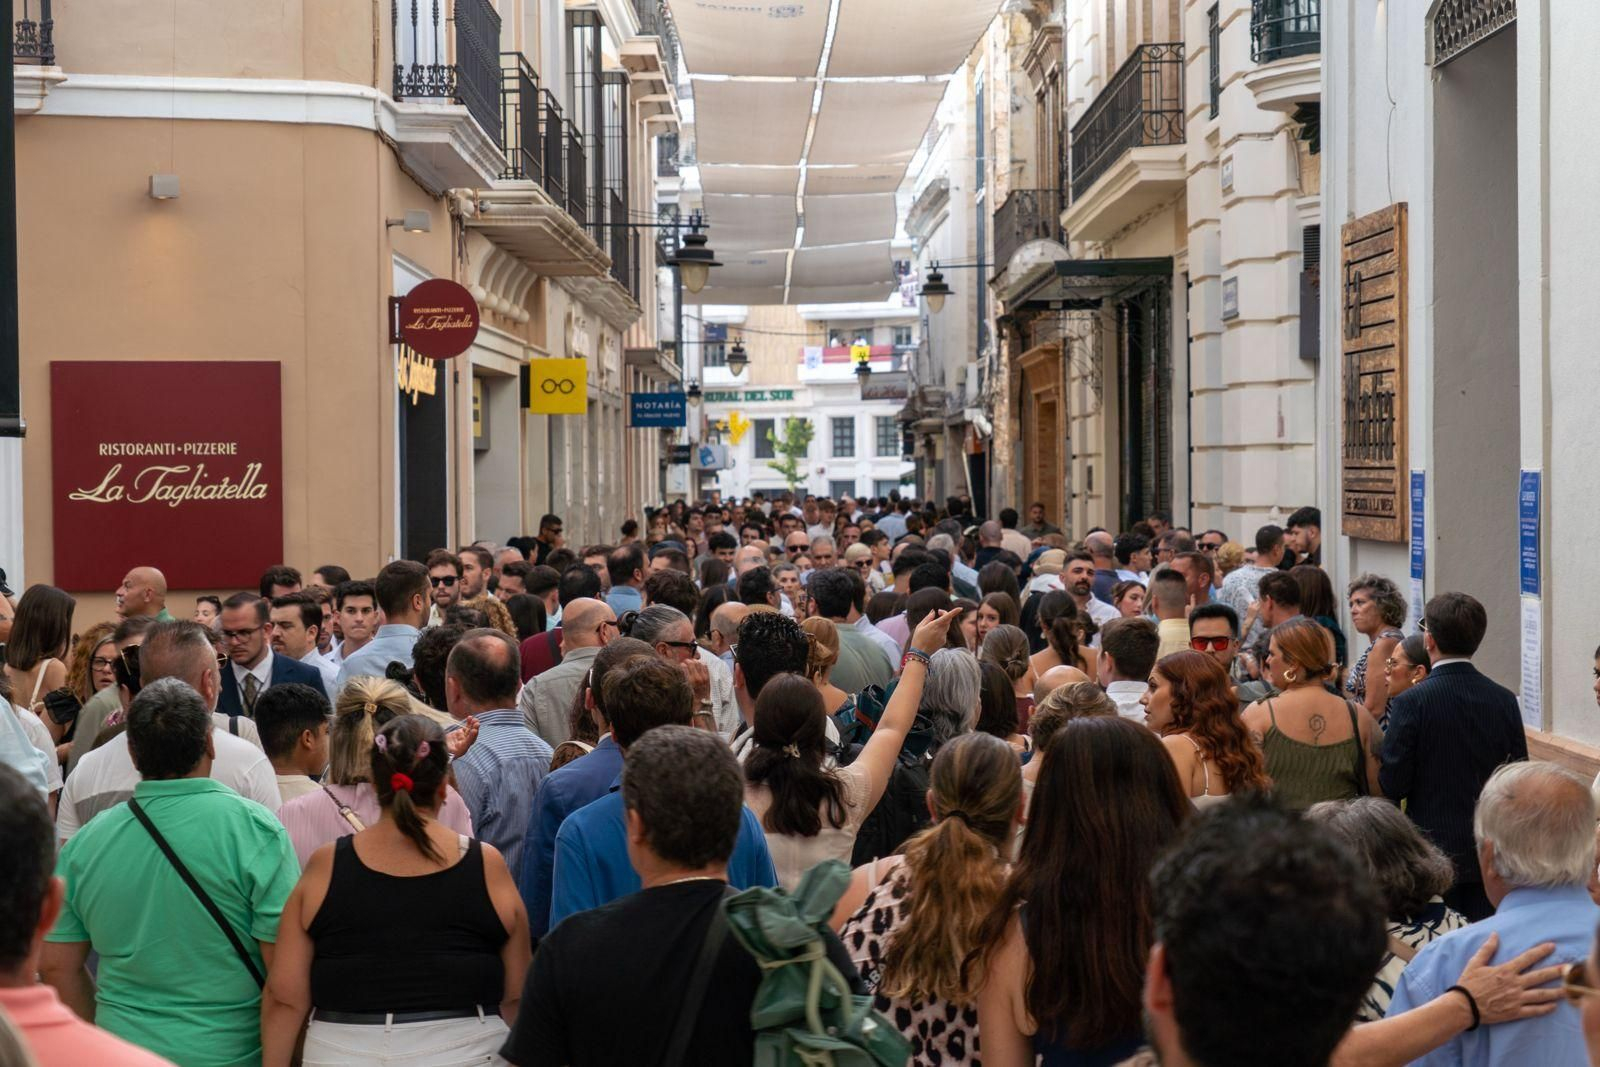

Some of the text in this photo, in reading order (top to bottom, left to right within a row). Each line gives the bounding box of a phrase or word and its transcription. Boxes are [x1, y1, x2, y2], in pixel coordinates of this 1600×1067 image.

[405, 314, 473, 331] La Tagliatella
[744, 390, 768, 401] DEL
[769, 389, 794, 401] SUR
[635, 400, 681, 409] NOTARÍA
[68, 462, 268, 508] La Tagliatella
